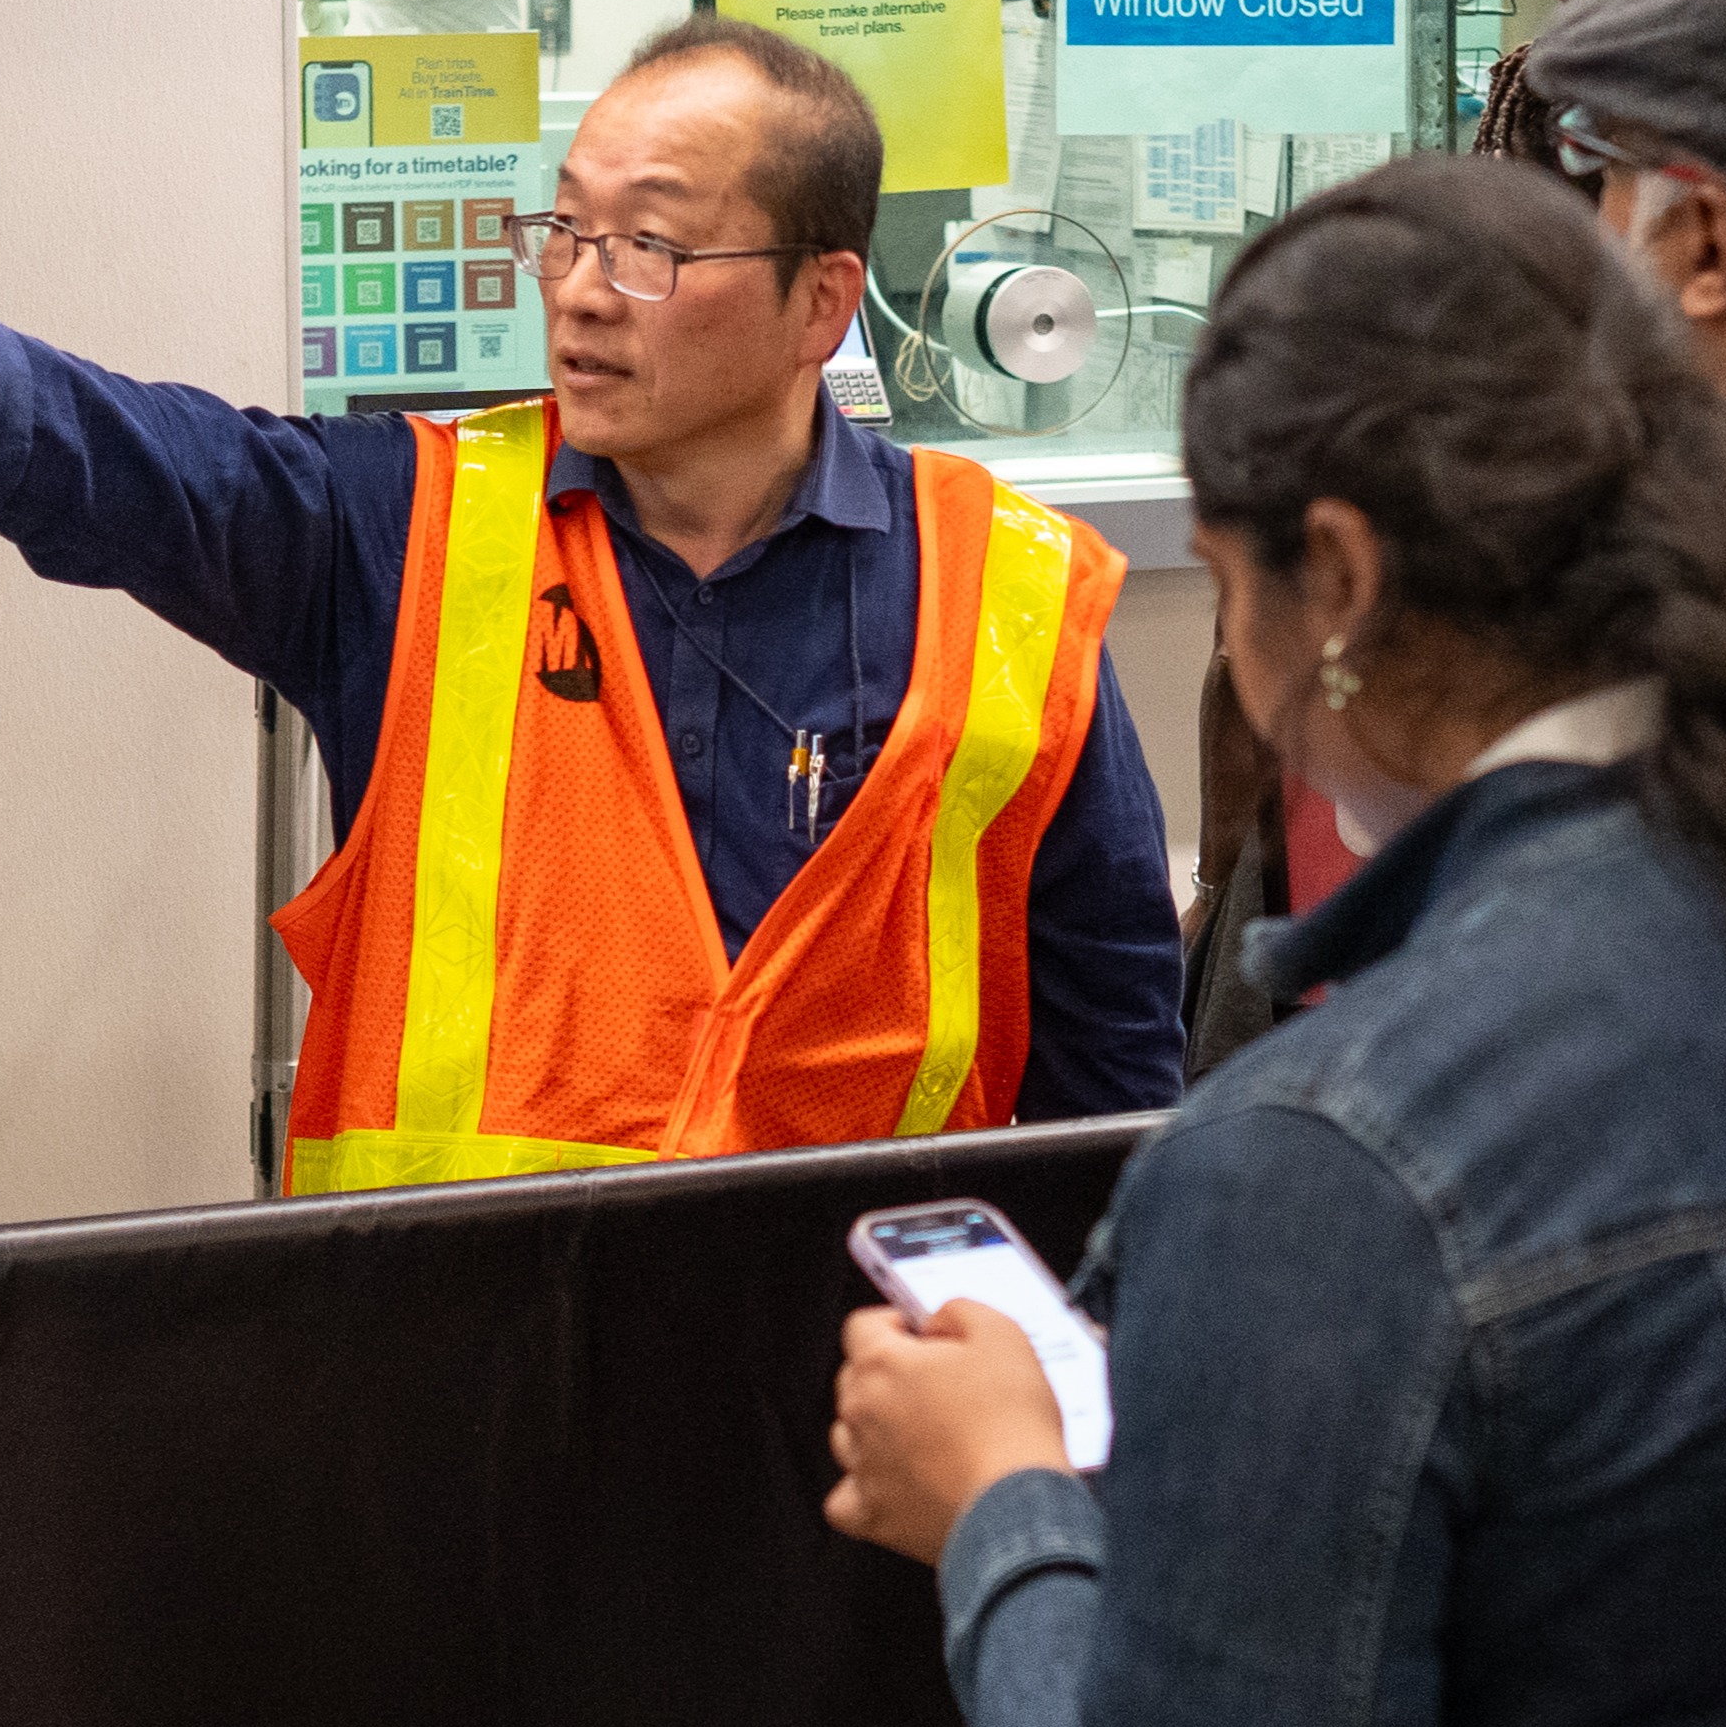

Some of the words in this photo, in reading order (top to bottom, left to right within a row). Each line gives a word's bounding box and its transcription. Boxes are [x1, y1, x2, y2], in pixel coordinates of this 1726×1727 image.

[776, 6, 825, 21] Please
[828, 4, 868, 19] make
[872, 1, 947, 17] alternative
[819, 23, 860, 36] travel
[863, 21, 906, 37] plans.
[365, 157, 393, 175] for
[397, 162, 408, 175] a
[412, 154, 518, 174] timetable?
